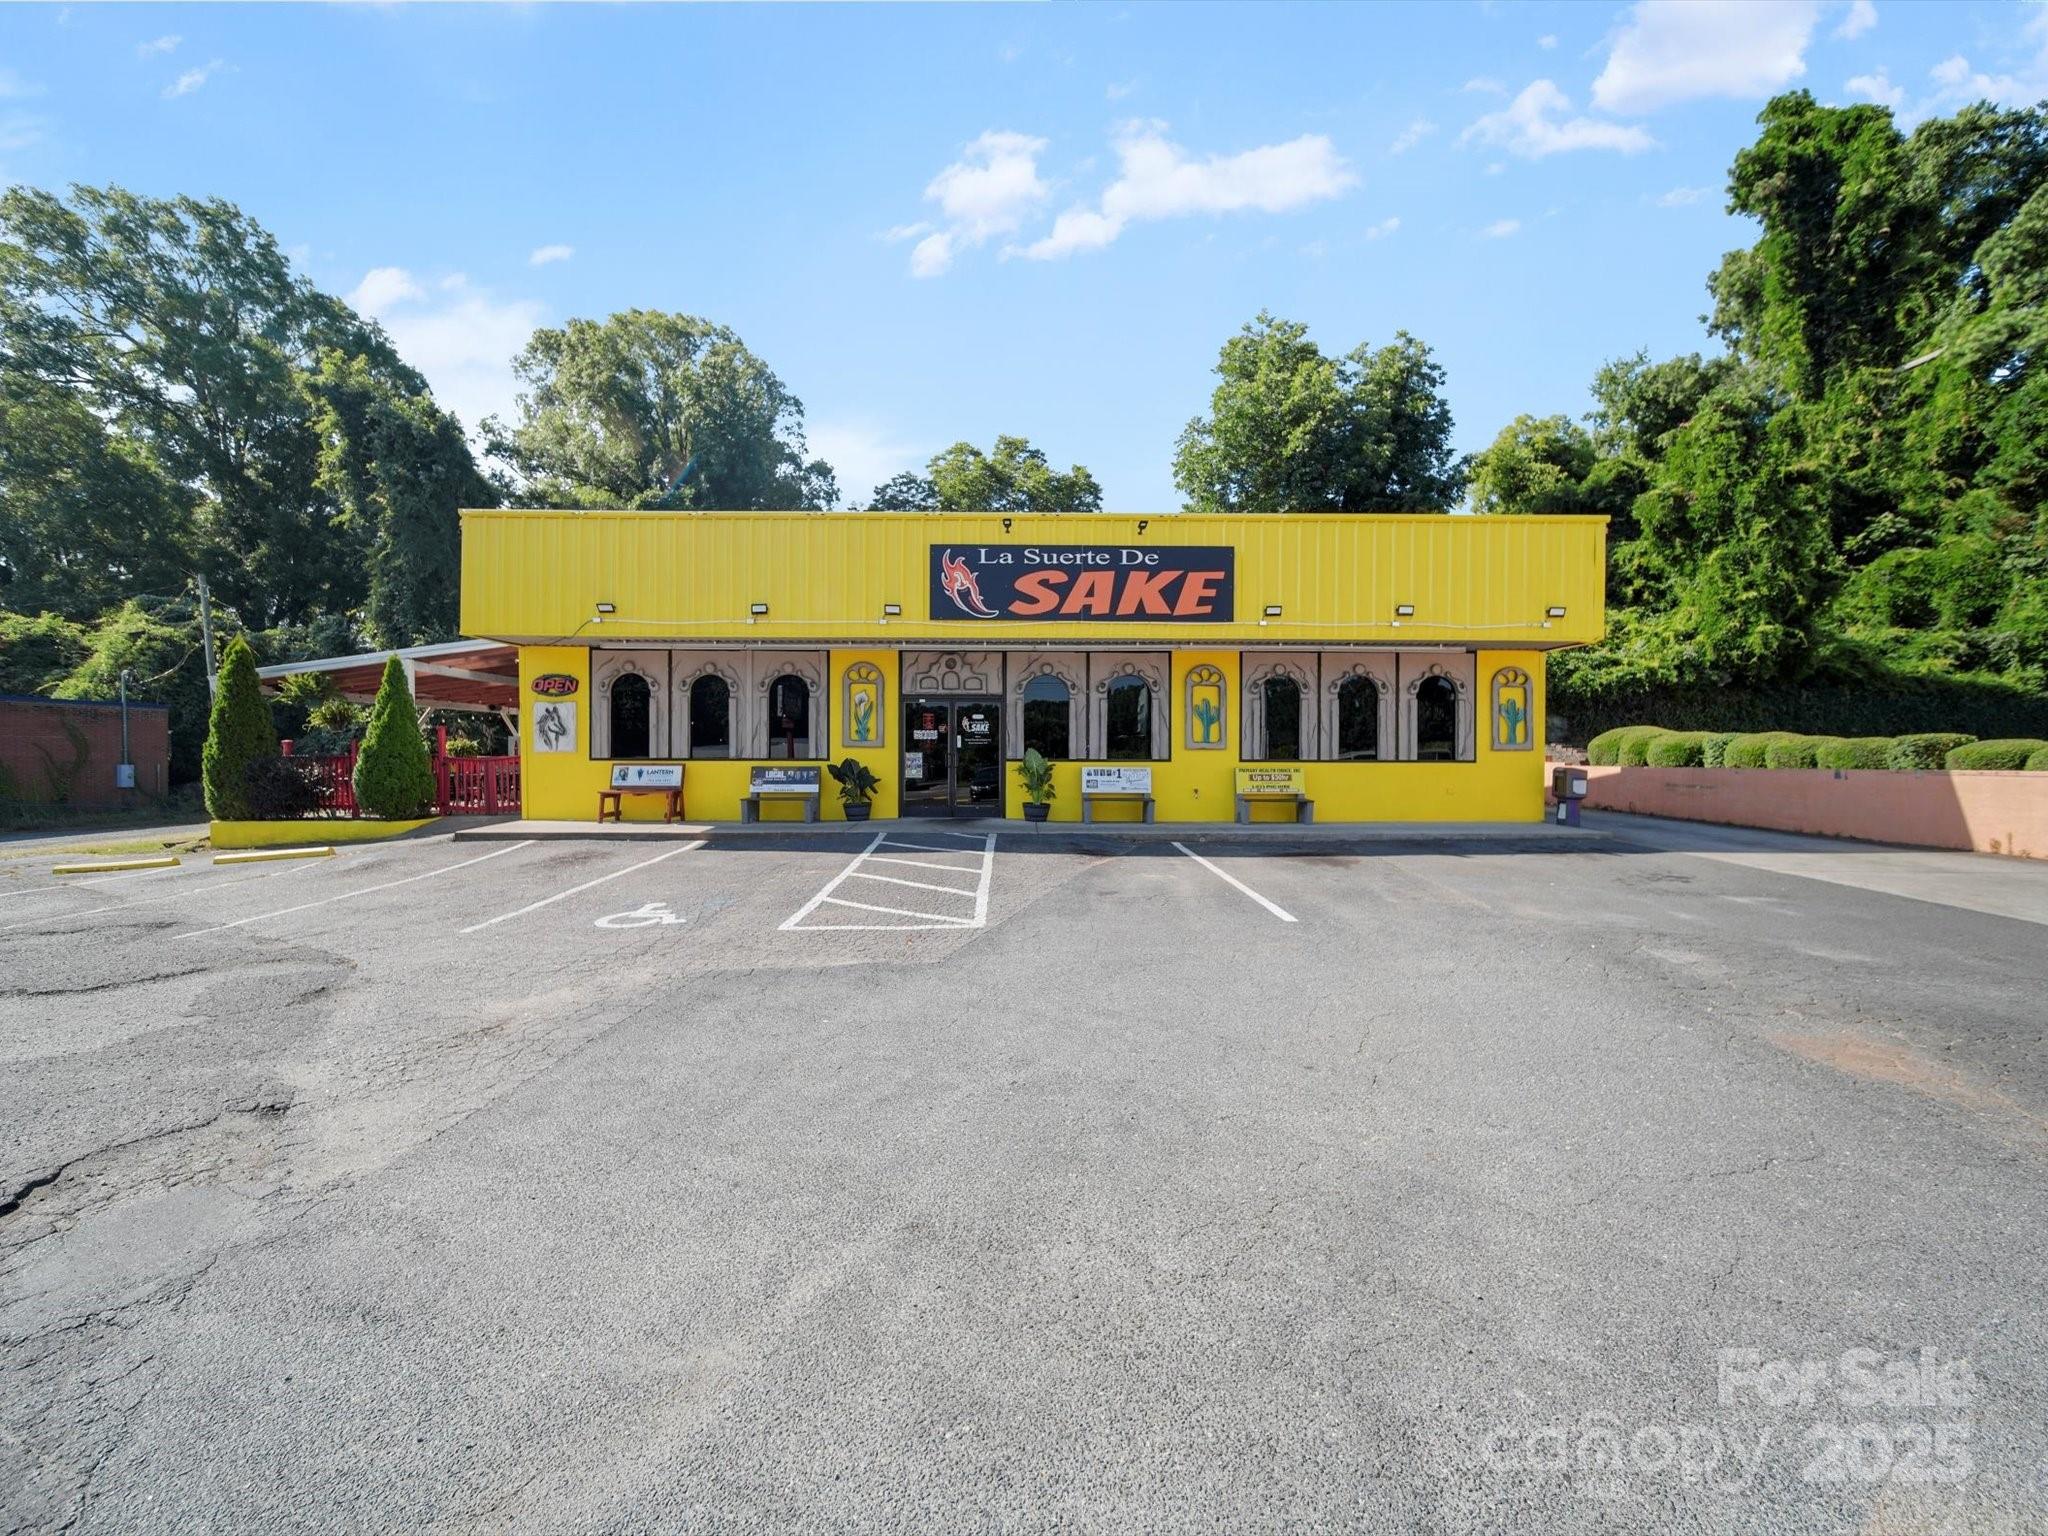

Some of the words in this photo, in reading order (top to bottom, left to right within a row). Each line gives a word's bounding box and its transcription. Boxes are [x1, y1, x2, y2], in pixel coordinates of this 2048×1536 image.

[978, 548, 1014, 564] La
[1024, 548, 1110, 565] Suerte
[1119, 549, 1159, 565] De
[1007, 569, 1225, 616] SAKE
[533, 678, 577, 692] OPEN
[971, 723, 990, 731] SAKE
[765, 770, 786, 778] LOCAL
